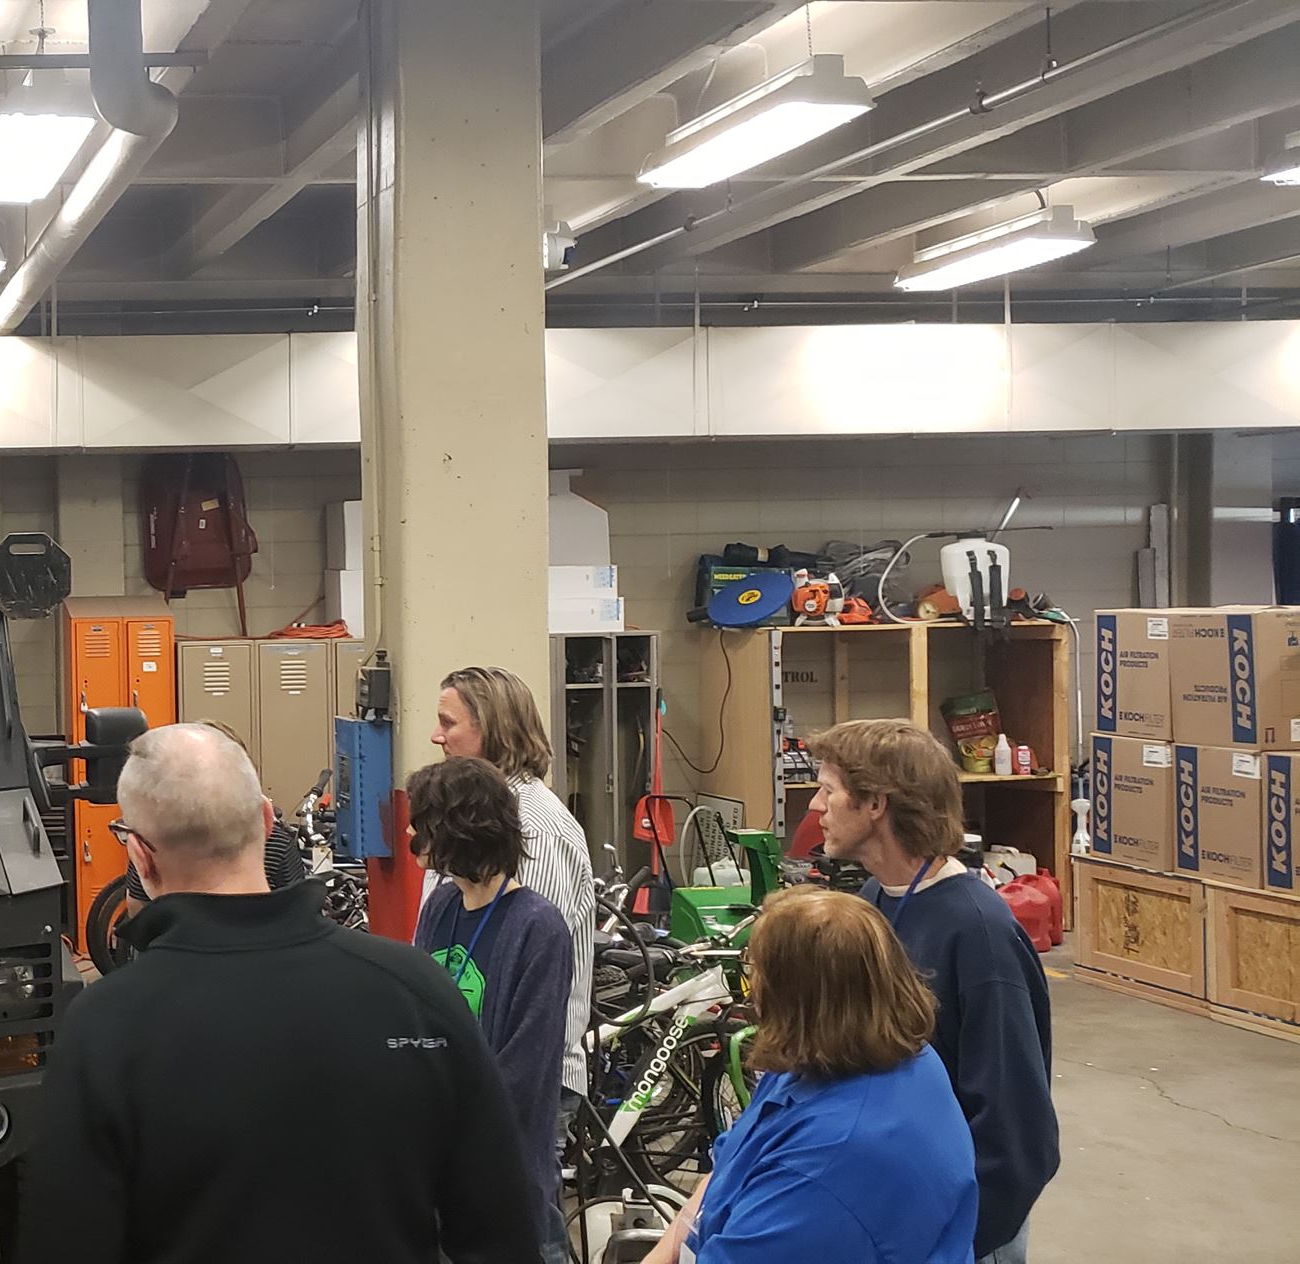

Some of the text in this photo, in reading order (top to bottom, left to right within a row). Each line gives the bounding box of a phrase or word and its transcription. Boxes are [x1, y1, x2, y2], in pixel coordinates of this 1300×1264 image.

[1119, 651, 1159, 660] AIR FILTRATION
[1119, 660, 1149, 668] PRODUCTS
[783, 671, 818, 683] TROL
[1101, 628, 1113, 719] KOCH
[1232, 628, 1252, 730] KOCH
[1114, 774, 1154, 786] AIR FILTRATION
[1096, 749, 1108, 841] KOCH
[1114, 783, 1143, 794] PRODUCTS
[1201, 786, 1246, 799] AIR FILTRATION
[1180, 759, 1195, 857] KOCH
[1201, 796, 1234, 807] PRODUCTS
[1270, 769, 1288, 874] KOCH
[628, 1014, 689, 1111] mongoose
